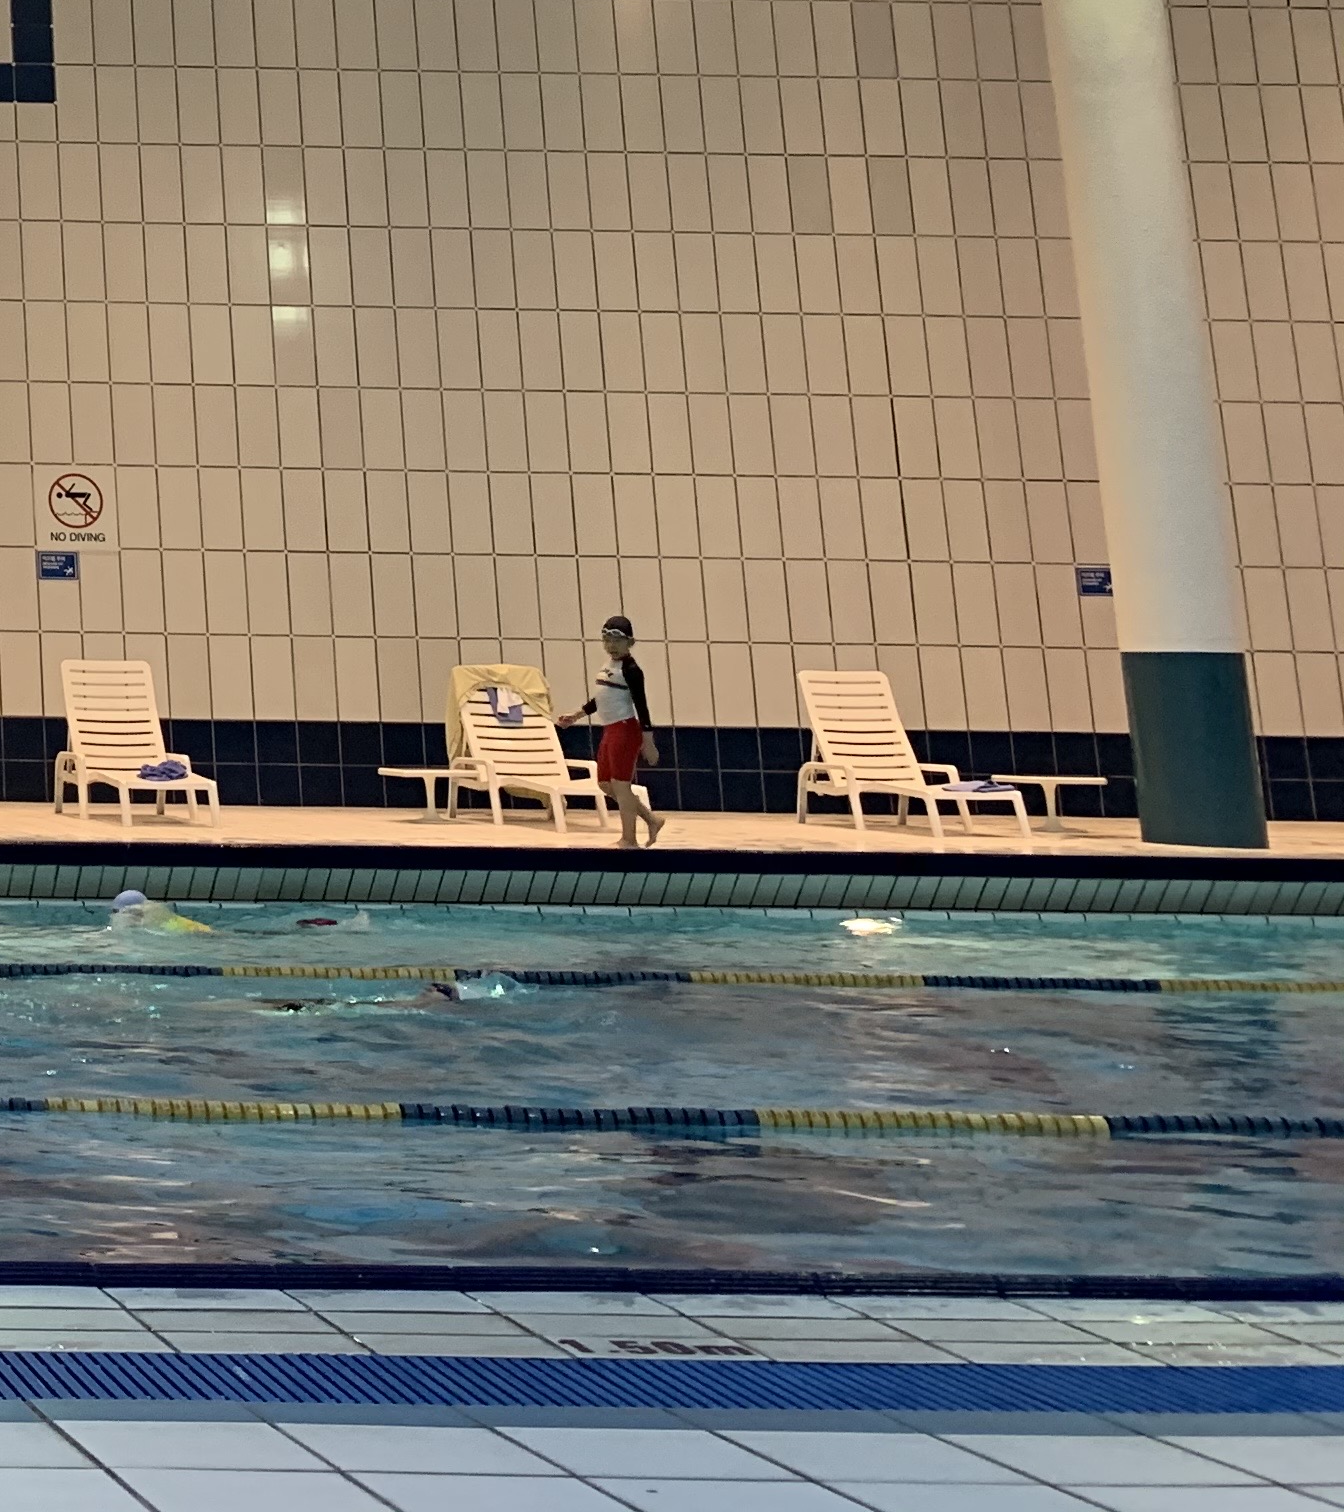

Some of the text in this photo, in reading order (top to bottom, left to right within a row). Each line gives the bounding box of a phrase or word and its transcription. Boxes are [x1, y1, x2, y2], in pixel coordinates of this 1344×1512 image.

[50, 531, 106, 543] NO DIVING
[558, 1339, 756, 1356] 1.50m
